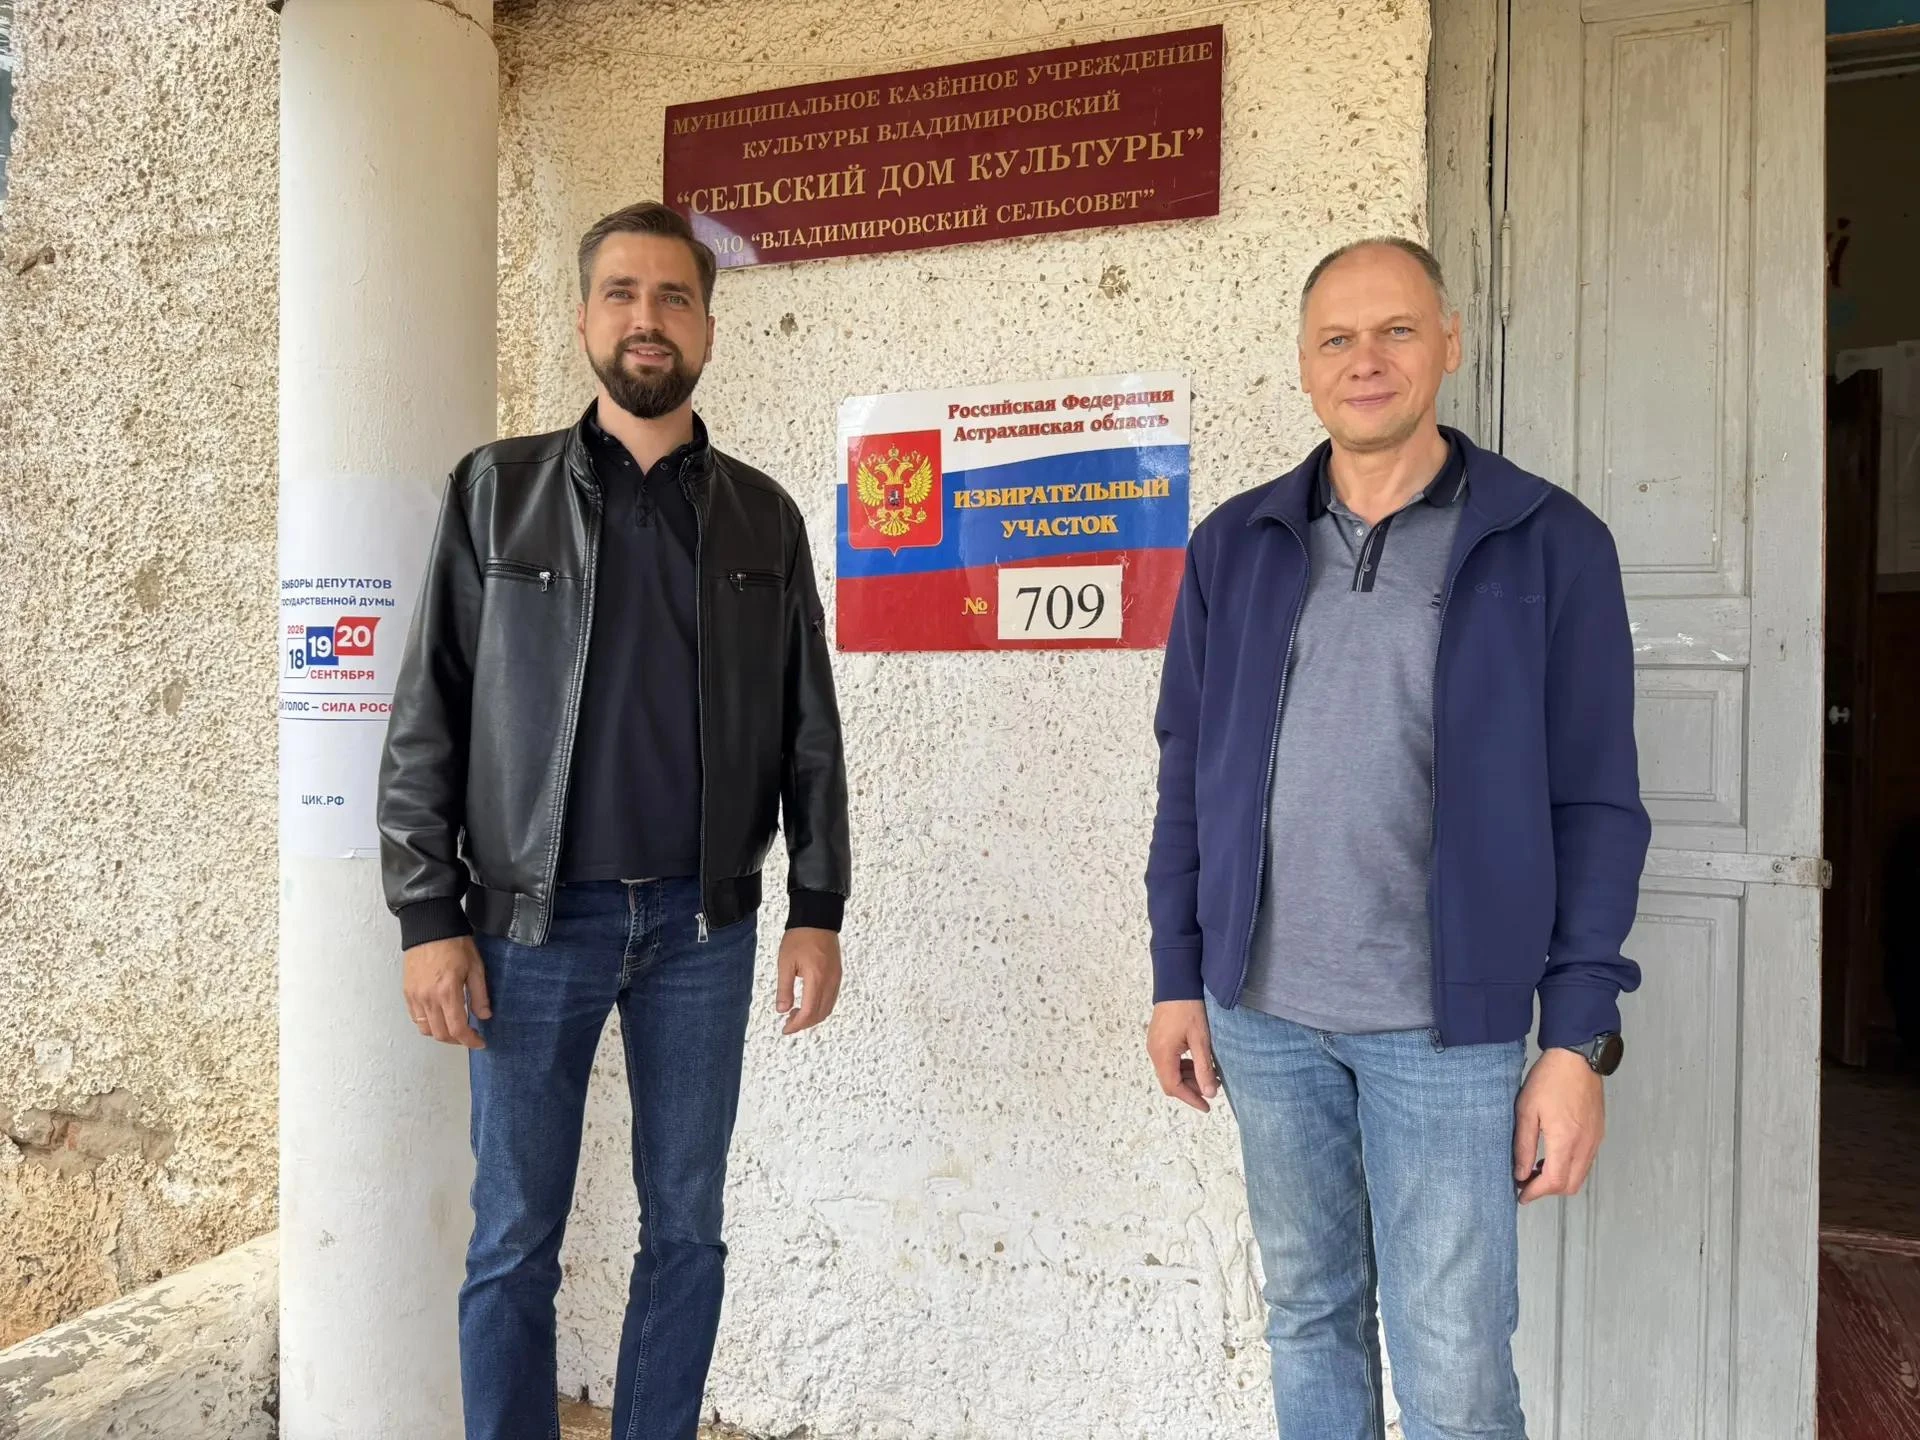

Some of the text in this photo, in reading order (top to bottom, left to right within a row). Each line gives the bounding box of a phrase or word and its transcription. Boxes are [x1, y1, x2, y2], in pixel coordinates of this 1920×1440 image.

[672, 42, 1213, 135] МУНИЦИПАЛЬНОЕ КАЗЁННОЕ УЧРЕЖДЕНИЕ
[743, 89, 1120, 160] КУЛЬТУРЫ ВЛАДИМИРОВСКИЙ
[877, 158, 955, 199] ДОМ
[714, 235, 744, 254] МО
[948, 389, 1174, 419] Российская Федерация
[953, 412, 1169, 443] Астраханская область
[953, 476, 1170, 509] ИЗБИРАТЕЛЬНЫЙ
[1001, 515, 1119, 539] УЧАСТОК
[281, 578, 392, 589] ВЫБОРЫ ДЕПУТАТОВ
[359, 597, 395, 607] ДУМЫ
[962, 583, 1105, 632] № 709
[287, 625, 305, 634] 2026
[289, 625, 371, 669] 18 19 20
[310, 669, 375, 680] СЕНТЯБРЯ
[285, 701, 310, 711] ГОЛОС
[322, 702, 356, 712] СИЛА
[302, 795, 345, 806] ЦИК.РФ
